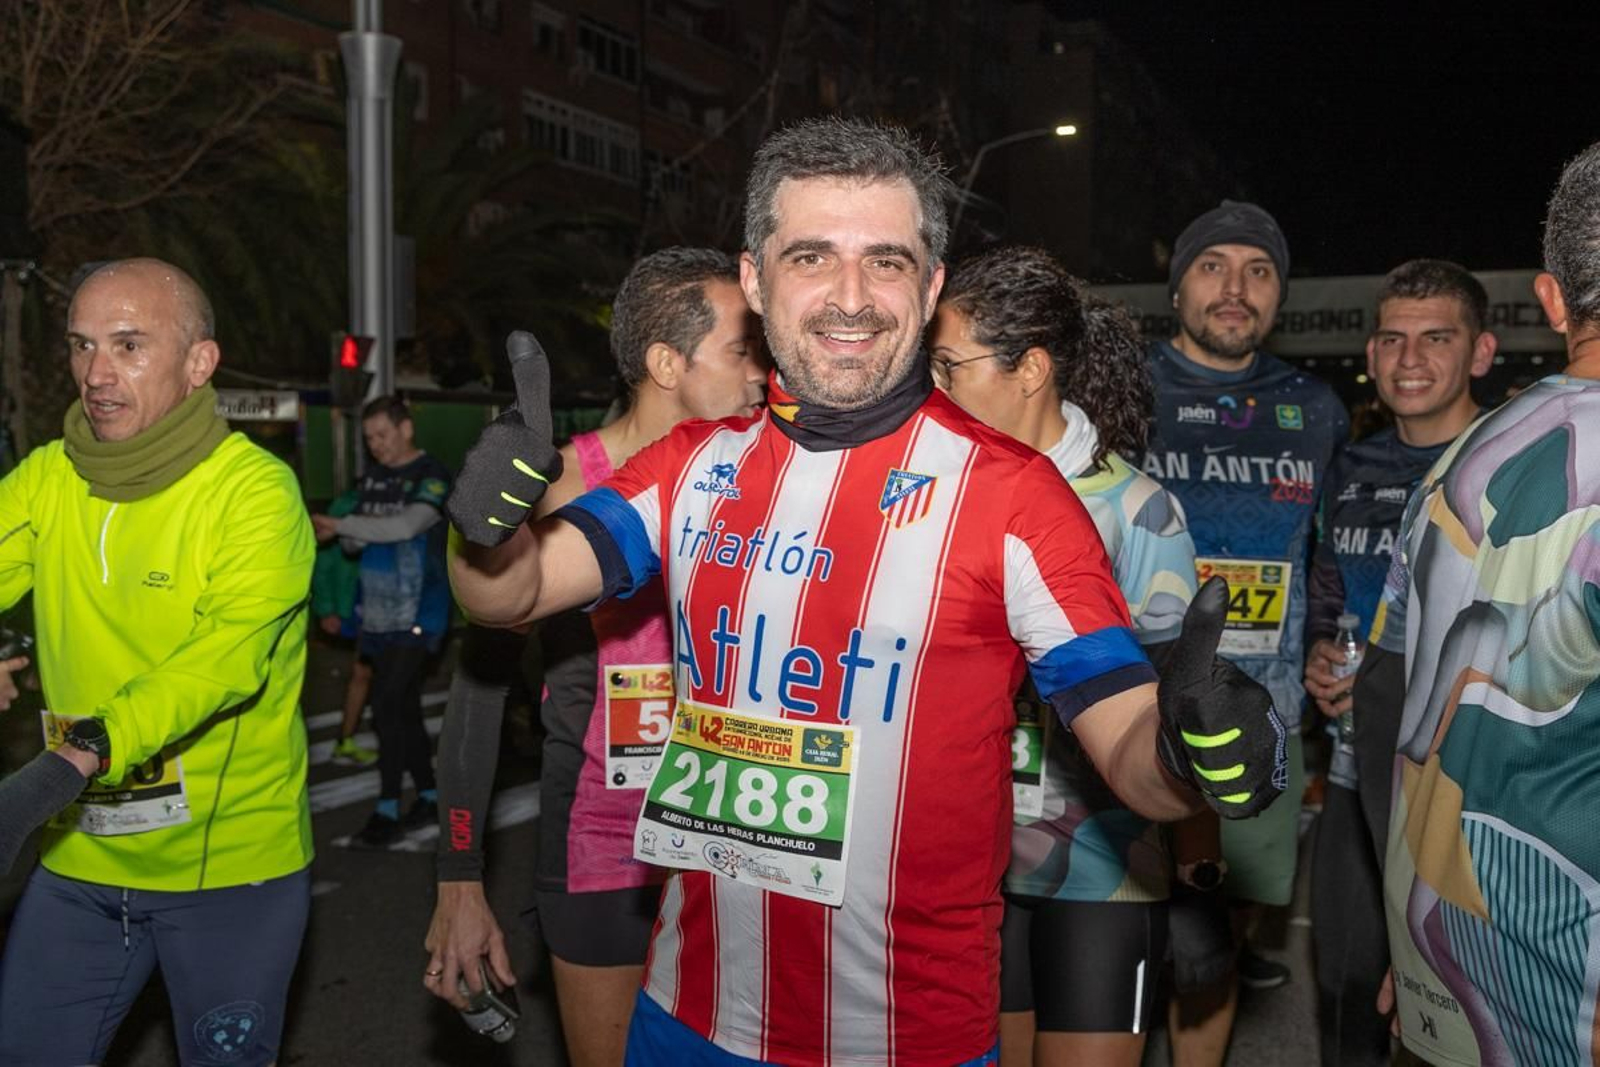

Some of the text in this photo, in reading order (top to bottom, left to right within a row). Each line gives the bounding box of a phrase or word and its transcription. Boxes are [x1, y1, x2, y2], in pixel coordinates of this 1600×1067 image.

[1142, 450, 1314, 489] AN ANTÓN
[678, 515, 834, 582] triatlón
[1228, 588, 1277, 619] 47
[677, 599, 907, 723] Atleti
[699, 714, 724, 746] 42
[722, 734, 746, 749] SAN
[658, 751, 830, 835] 2188
[660, 810, 816, 851] ALBERTO DE LAS HERAS PLANCHUELO
